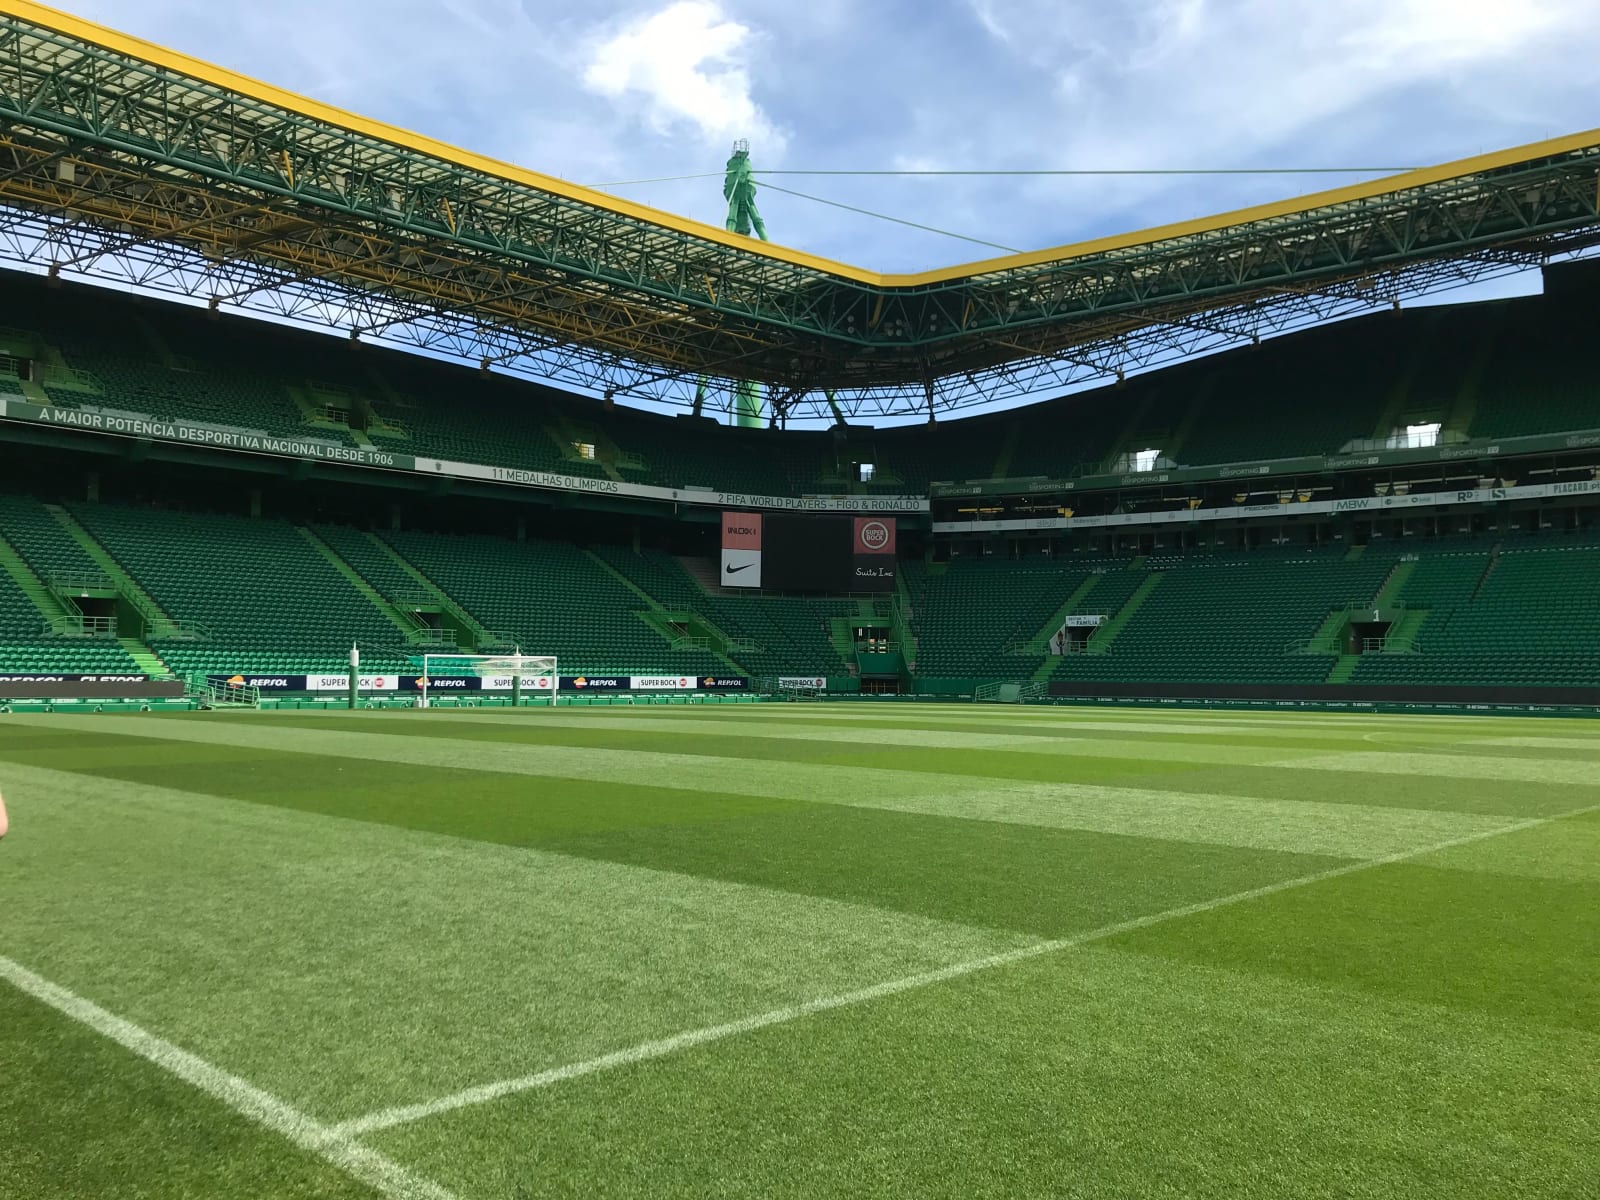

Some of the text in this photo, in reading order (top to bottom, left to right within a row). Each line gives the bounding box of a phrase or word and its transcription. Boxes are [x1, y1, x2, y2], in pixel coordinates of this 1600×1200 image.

[39, 408, 394, 465] A MAIOR POTÊNCIA DESPORTIVA NACIONAL DESDE 1906
[492, 468, 619, 492] 11 MEDALHAS OLÍMPICAS
[718, 494, 724, 503] 2
[726, 495, 746, 505] FIFA
[750, 496, 783, 507] WORLD
[785, 498, 828, 509] PLAYERS
[836, 500, 859, 509] FIGO
[861, 500, 869, 509] &
[871, 500, 920, 509] RONALDO
[1372, 609, 1380, 622] 1
[321, 678, 346, 686] SUPER
[434, 679, 466, 687] REPSOL
